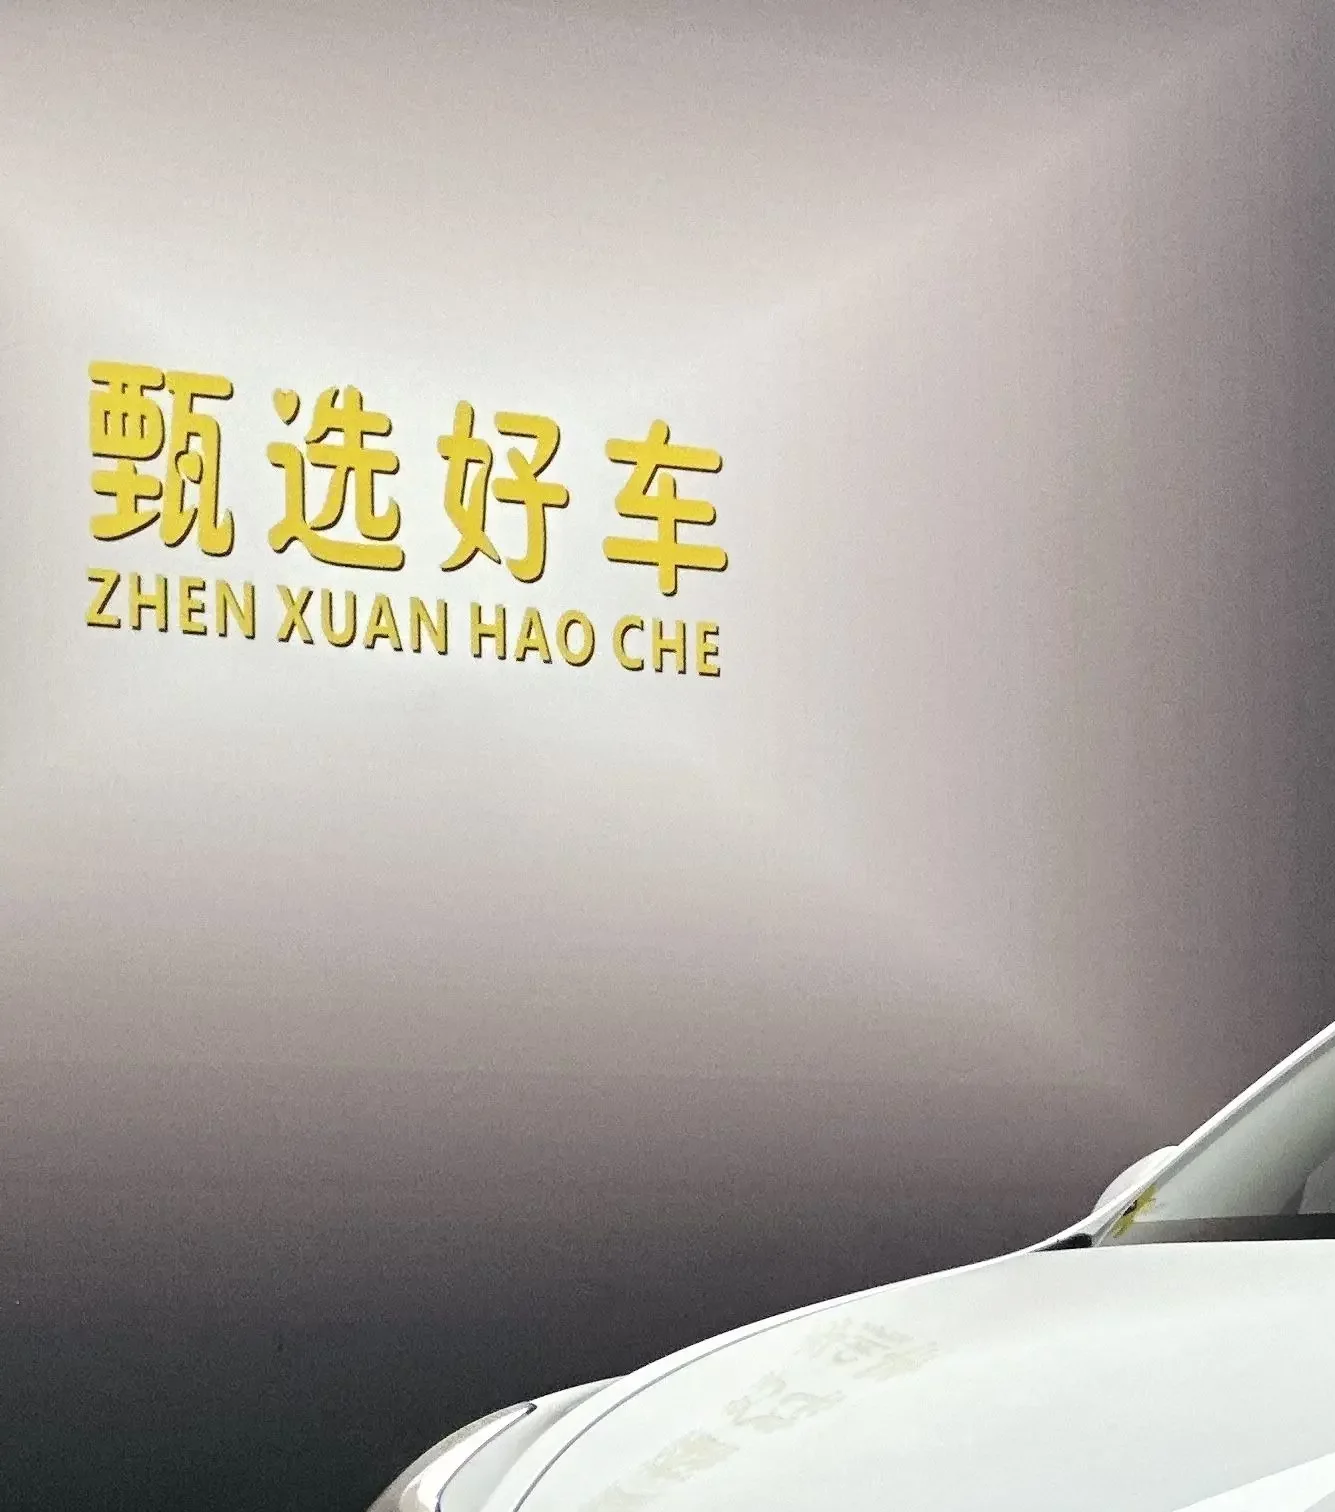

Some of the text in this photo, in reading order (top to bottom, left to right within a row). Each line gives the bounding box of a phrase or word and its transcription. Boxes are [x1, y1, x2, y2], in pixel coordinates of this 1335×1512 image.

[88, 360, 730, 596] 甄选好车
[85, 567, 722, 677] ZHEN XUAN HAO CHE
